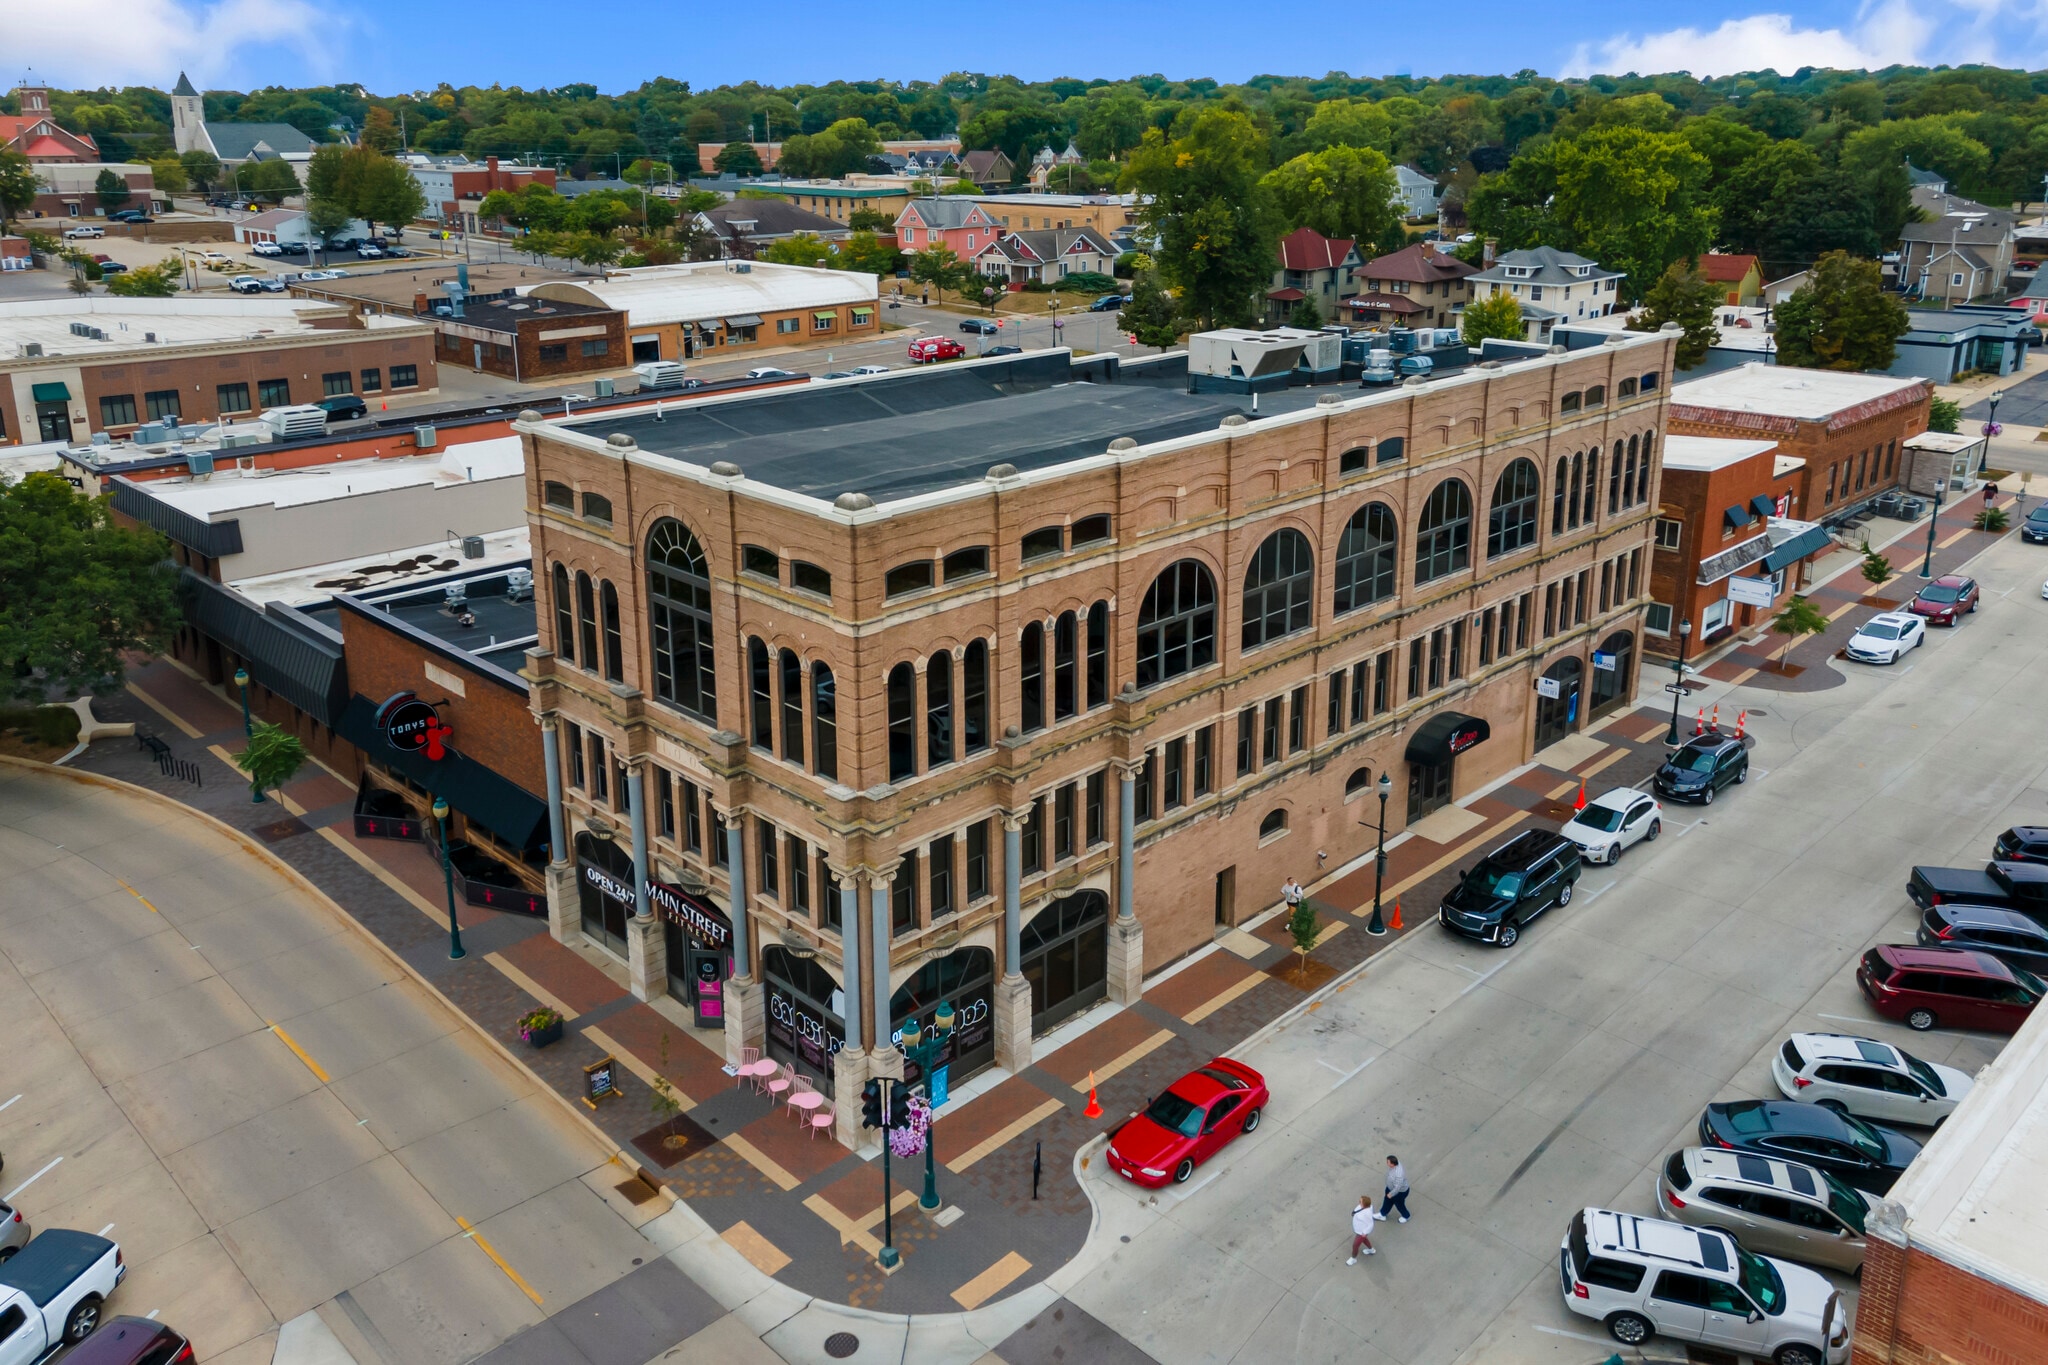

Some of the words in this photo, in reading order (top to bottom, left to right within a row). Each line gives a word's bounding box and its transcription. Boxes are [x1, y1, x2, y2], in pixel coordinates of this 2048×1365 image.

[390, 719, 425, 735] TONYS
[587, 867, 614, 892] OPEN
[614, 884, 636, 904] 24/7
[644, 880, 680, 914] MAIN
[681, 903, 728, 943] STREET
[668, 911, 715, 946] FITNESS
